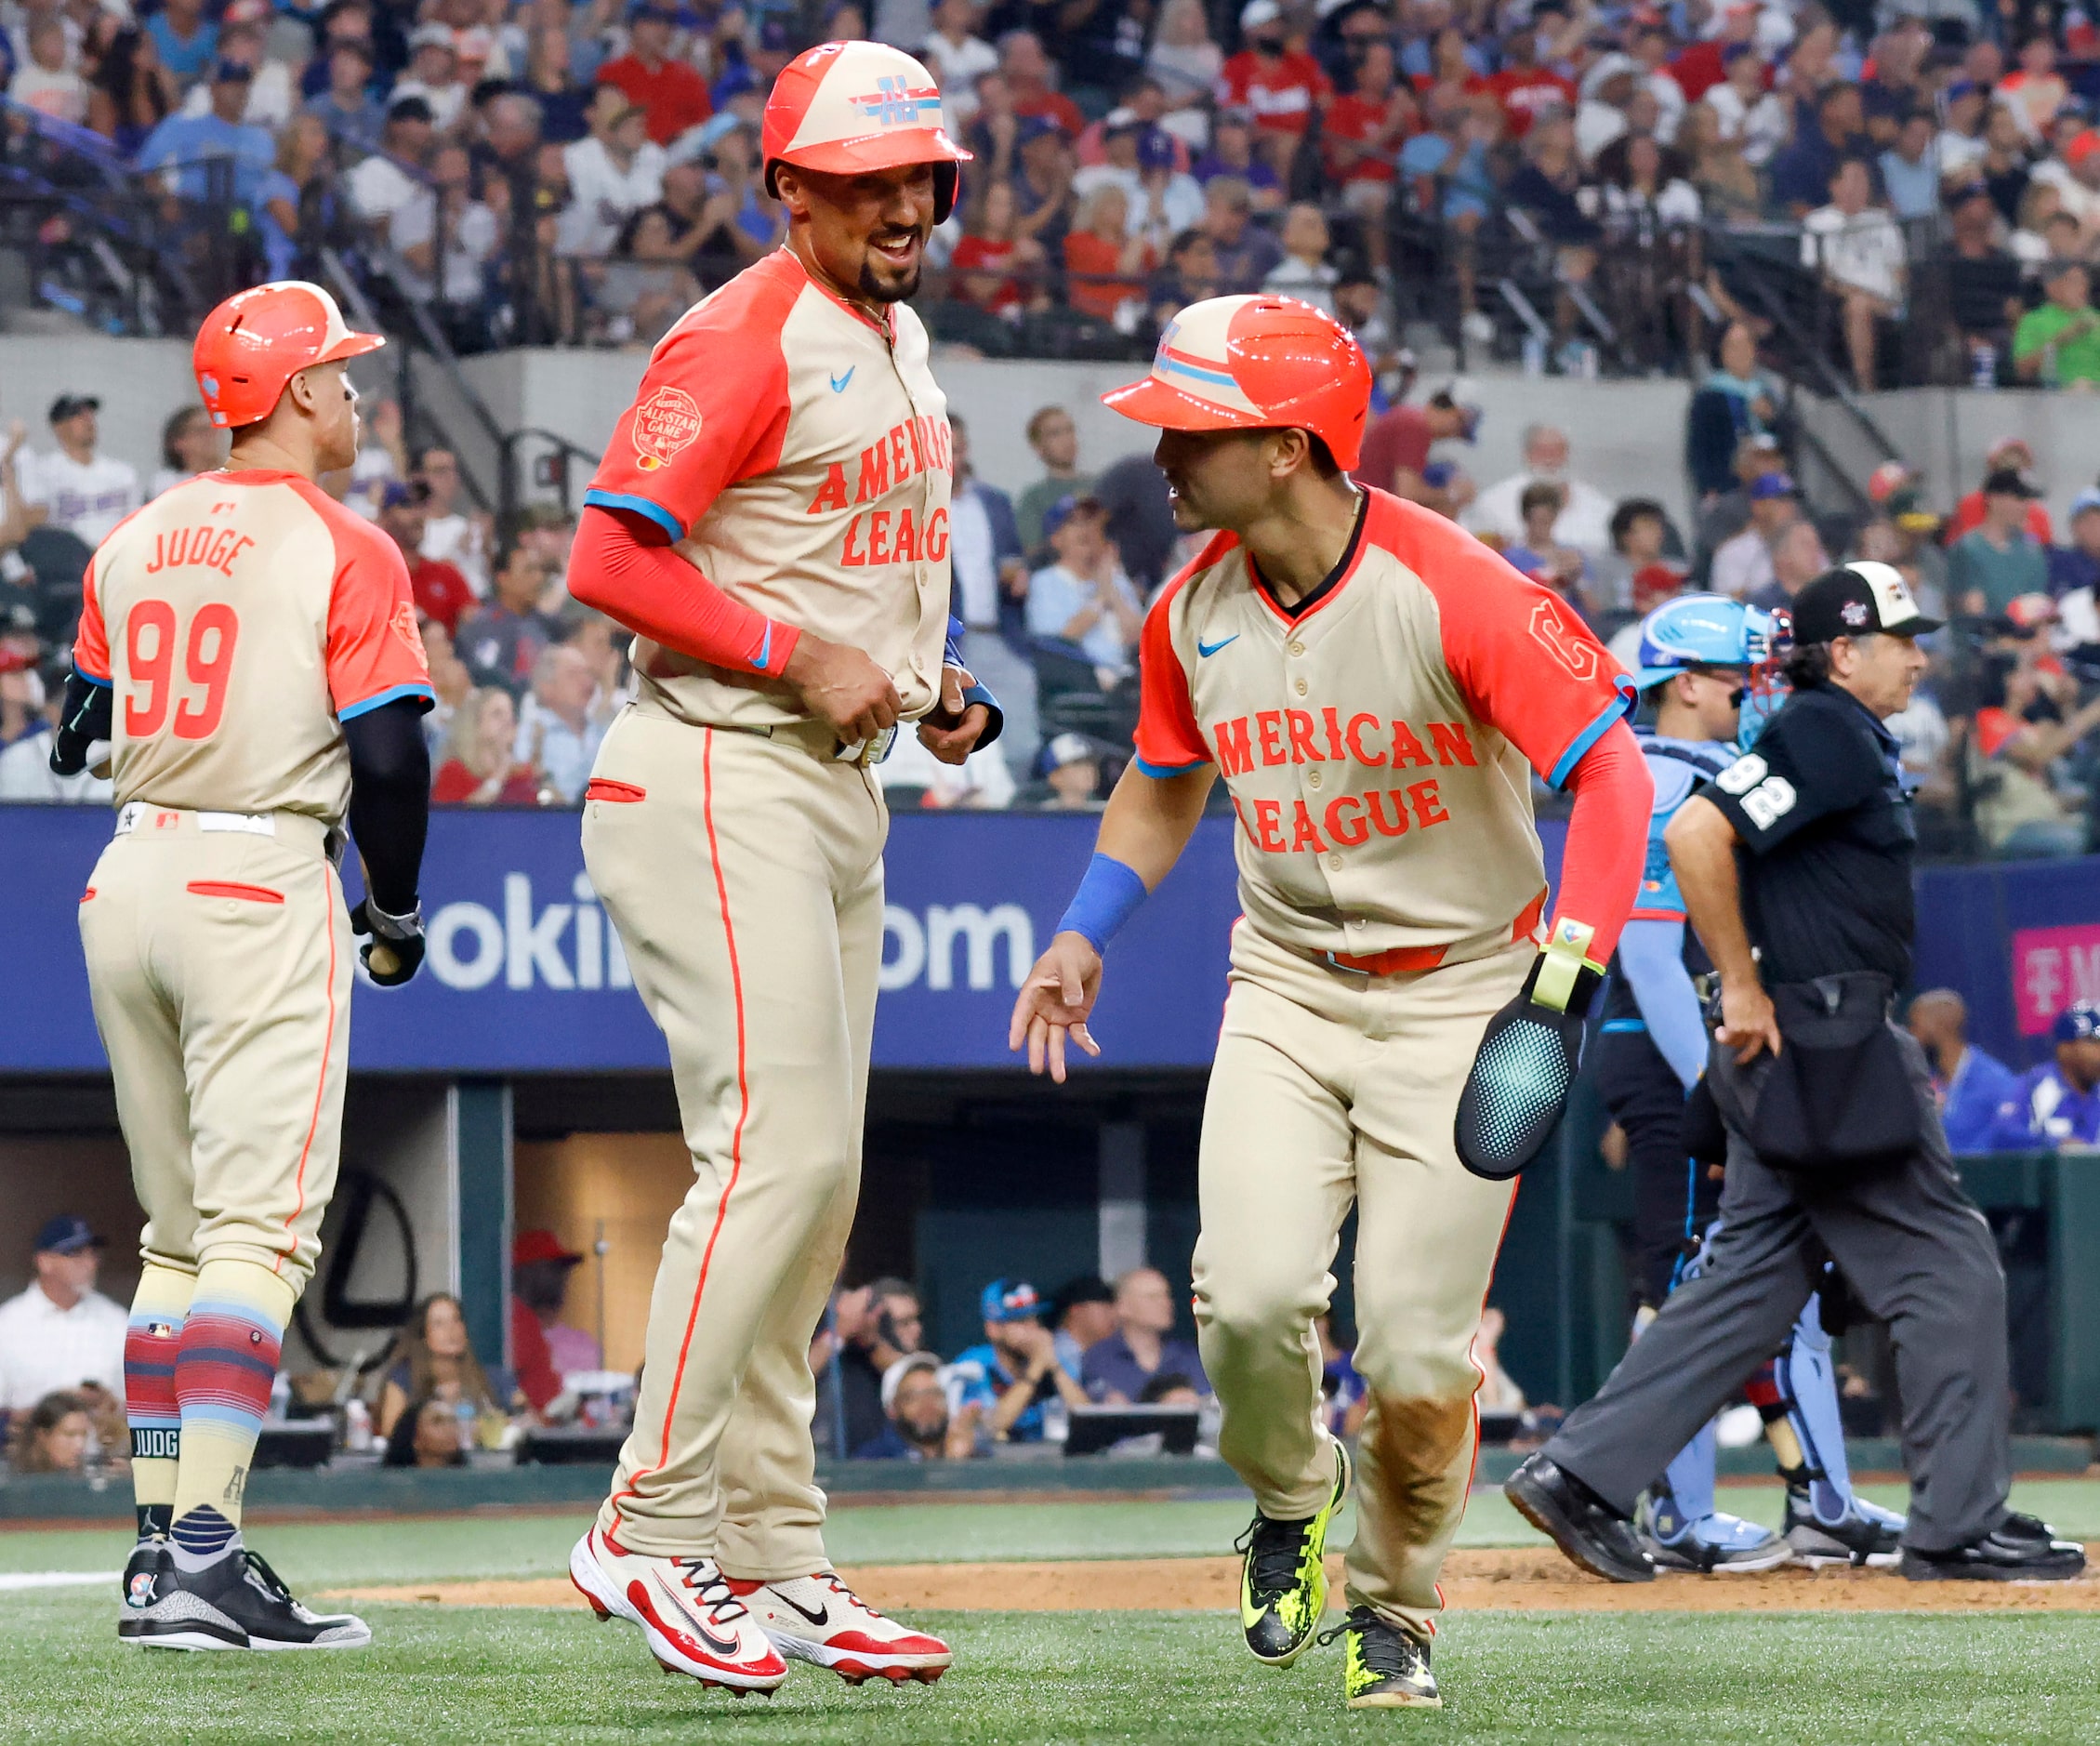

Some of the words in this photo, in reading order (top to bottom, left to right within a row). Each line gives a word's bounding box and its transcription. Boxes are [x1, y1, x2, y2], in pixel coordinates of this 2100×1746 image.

[647, 419, 682, 439] GAME
[806, 416, 954, 515] AMERIC
[146, 526, 256, 577] JUDGE
[840, 508, 948, 566] LEAG
[125, 600, 239, 740] 99
[1213, 707, 1478, 778] MERICAN
[1715, 753, 1796, 831] 92
[136, 1429, 178, 1457] JUDG
